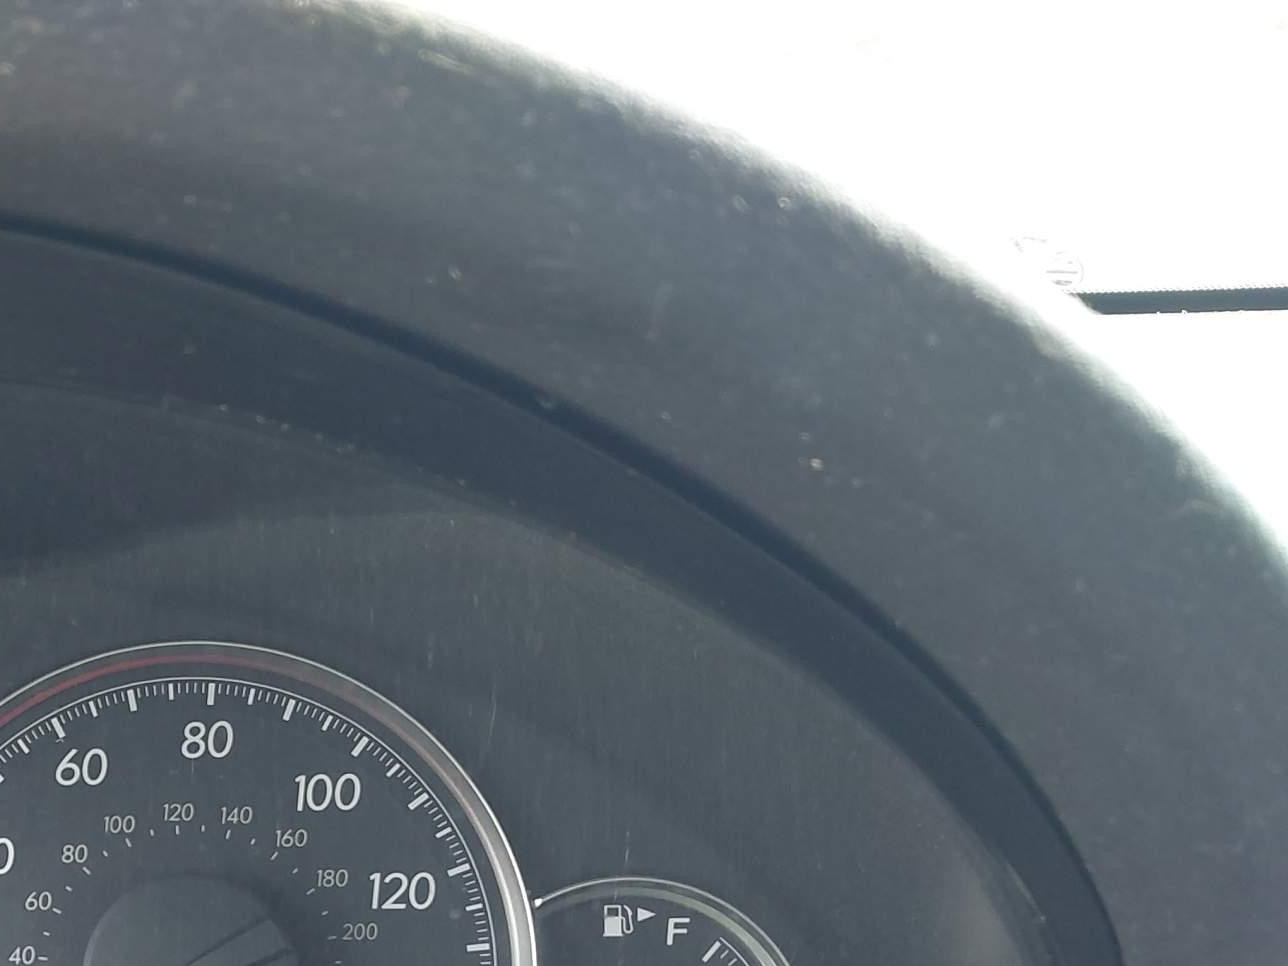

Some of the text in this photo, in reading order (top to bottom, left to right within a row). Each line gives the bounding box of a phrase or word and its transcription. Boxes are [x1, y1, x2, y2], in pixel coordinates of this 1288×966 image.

[182, 721, 233, 758] 80
[56, 749, 107, 785] 60
[295, 774, 360, 811] 100
[164, 804, 193, 821] 120
[222, 807, 252, 824] 140
[104, 816, 135, 833] 100
[276, 829, 307, 847] 160
[62, 845, 87, 863] 80
[318, 869, 348, 887] 180
[370, 872, 435, 909] 120
[25, 892, 51, 910] 60
[342, 923, 378, 940] 200
[667, 918, 690, 945] F
[9, 946, 35, 964] 40
